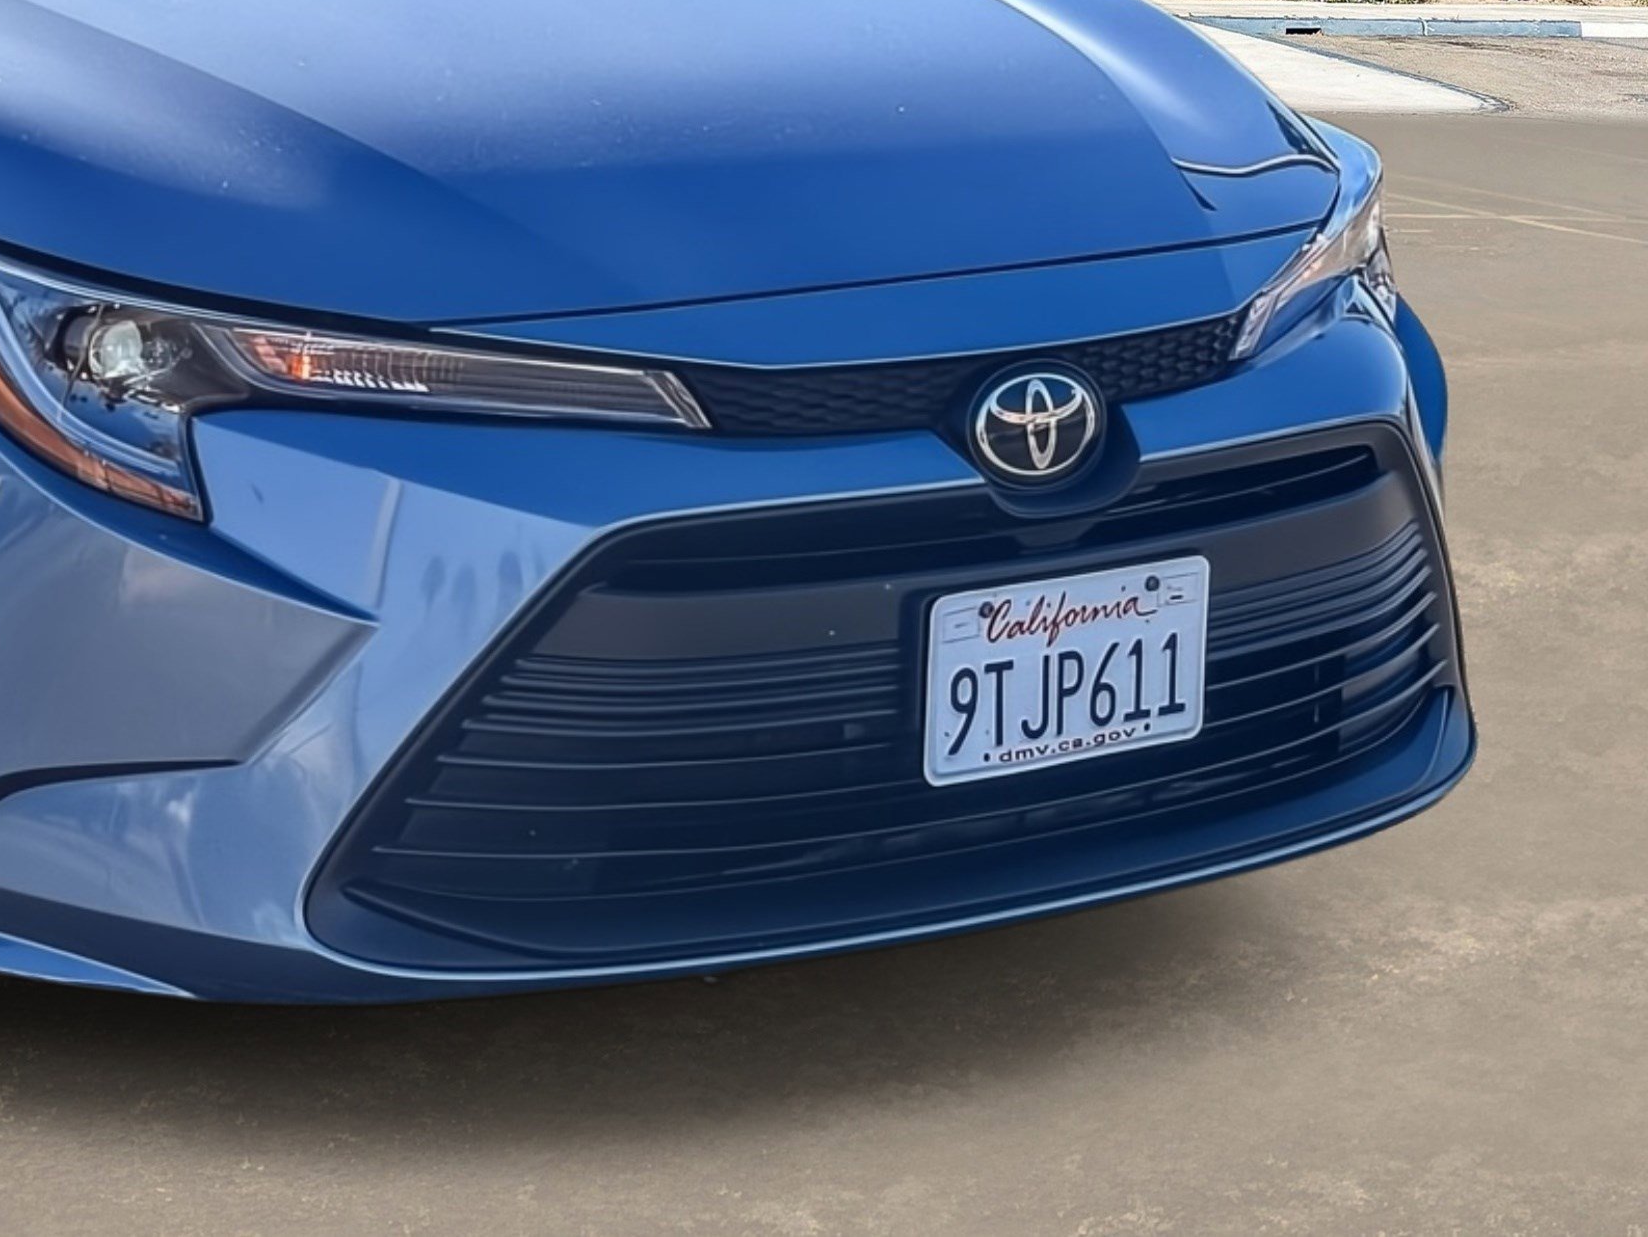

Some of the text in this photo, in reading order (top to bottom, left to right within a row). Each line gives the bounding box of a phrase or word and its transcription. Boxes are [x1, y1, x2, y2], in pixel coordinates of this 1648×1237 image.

[986, 590, 1158, 648] California
[947, 631, 1187, 756] 9TJP611
[998, 724, 1138, 763] dmv.ca.gov
